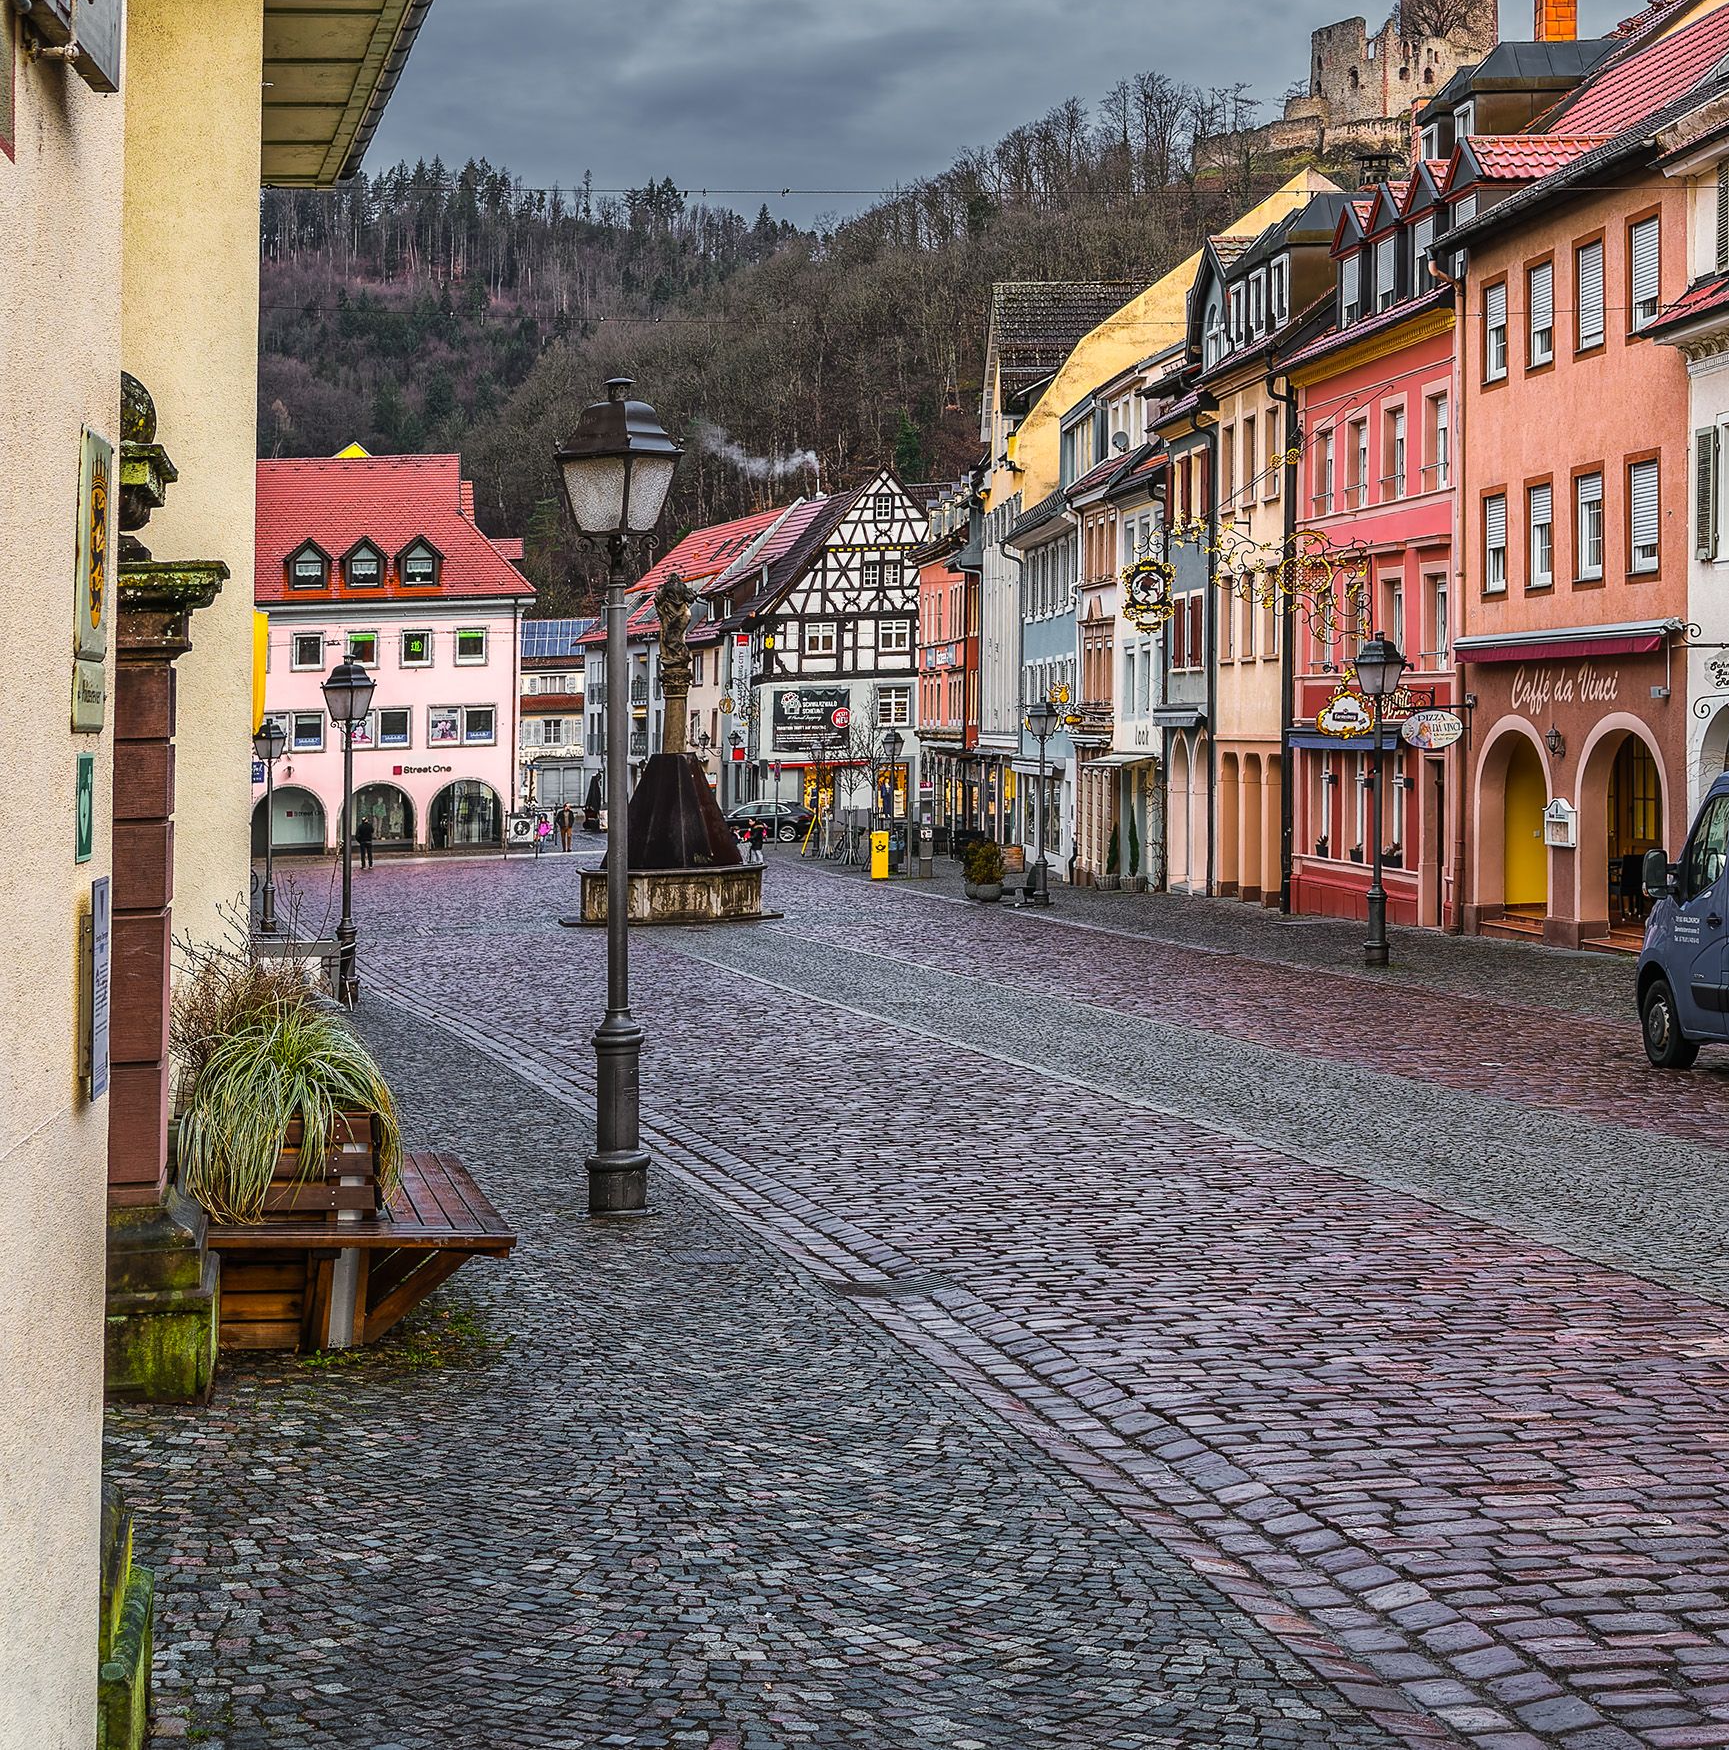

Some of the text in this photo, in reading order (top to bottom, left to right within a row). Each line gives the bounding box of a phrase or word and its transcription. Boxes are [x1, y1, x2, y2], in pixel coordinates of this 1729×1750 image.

[1553, 667, 1575, 704] da
[1577, 661, 1619, 703] Vinci
[404, 765, 452, 774] Street One
